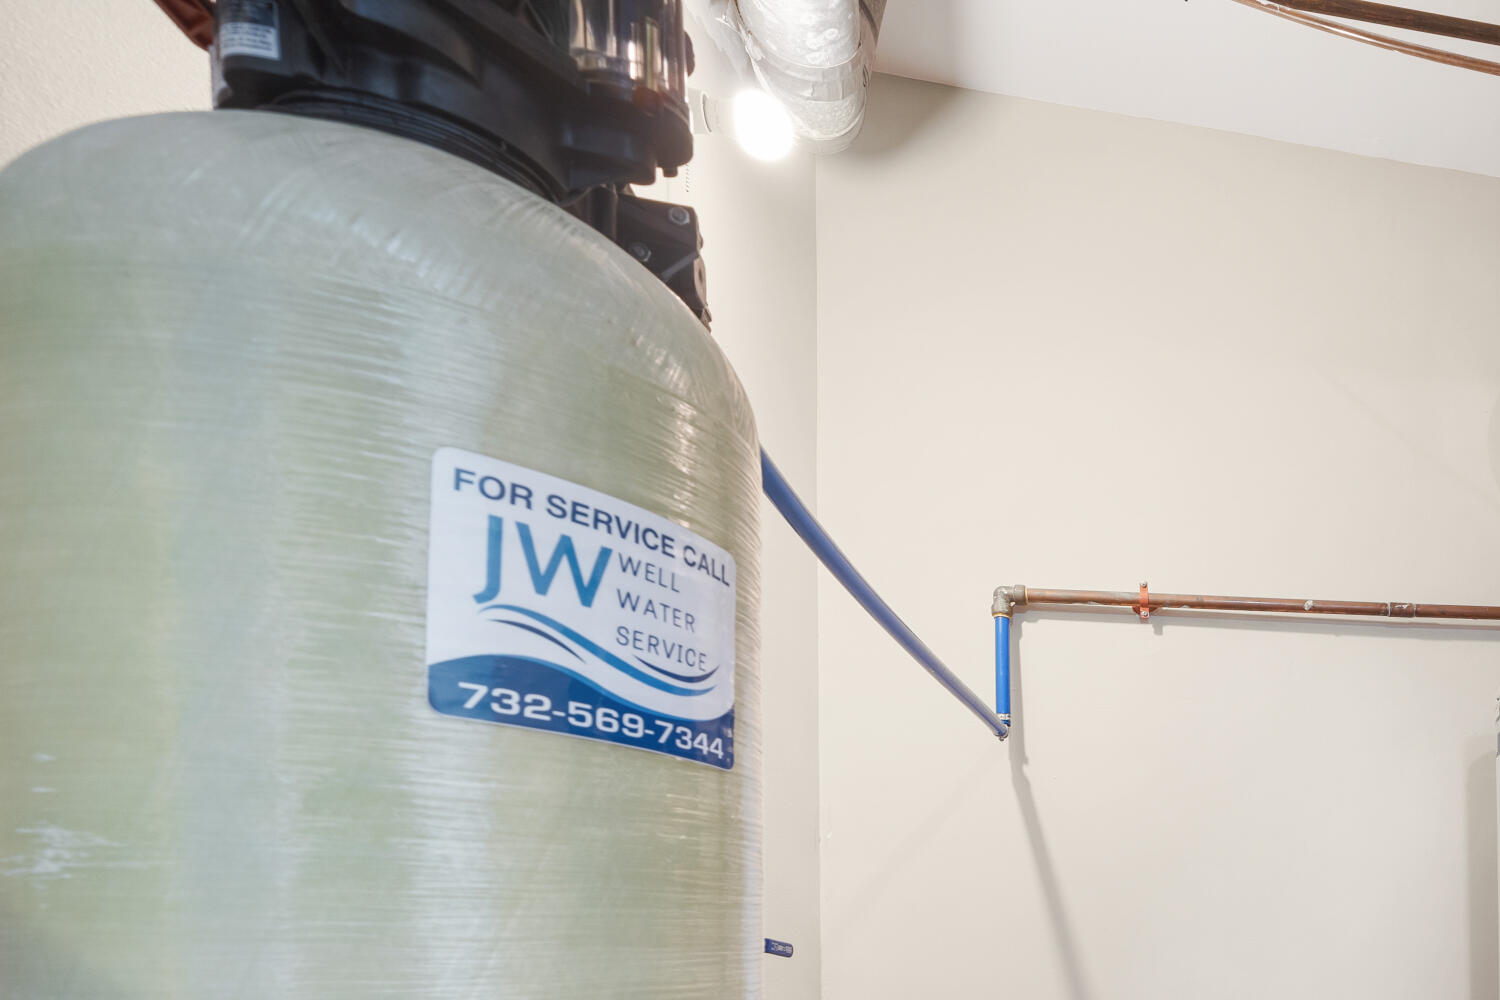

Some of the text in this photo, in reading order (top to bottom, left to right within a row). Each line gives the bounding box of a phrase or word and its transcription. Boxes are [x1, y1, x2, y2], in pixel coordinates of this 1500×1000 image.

[453, 467, 730, 587] FOR SERVICE CALL
[472, 513, 614, 609] JW
[618, 552, 680, 593] WELL
[616, 588, 696, 633] WATER
[615, 625, 707, 672] SERVICE
[457, 681, 724, 760] 732-569-7344
